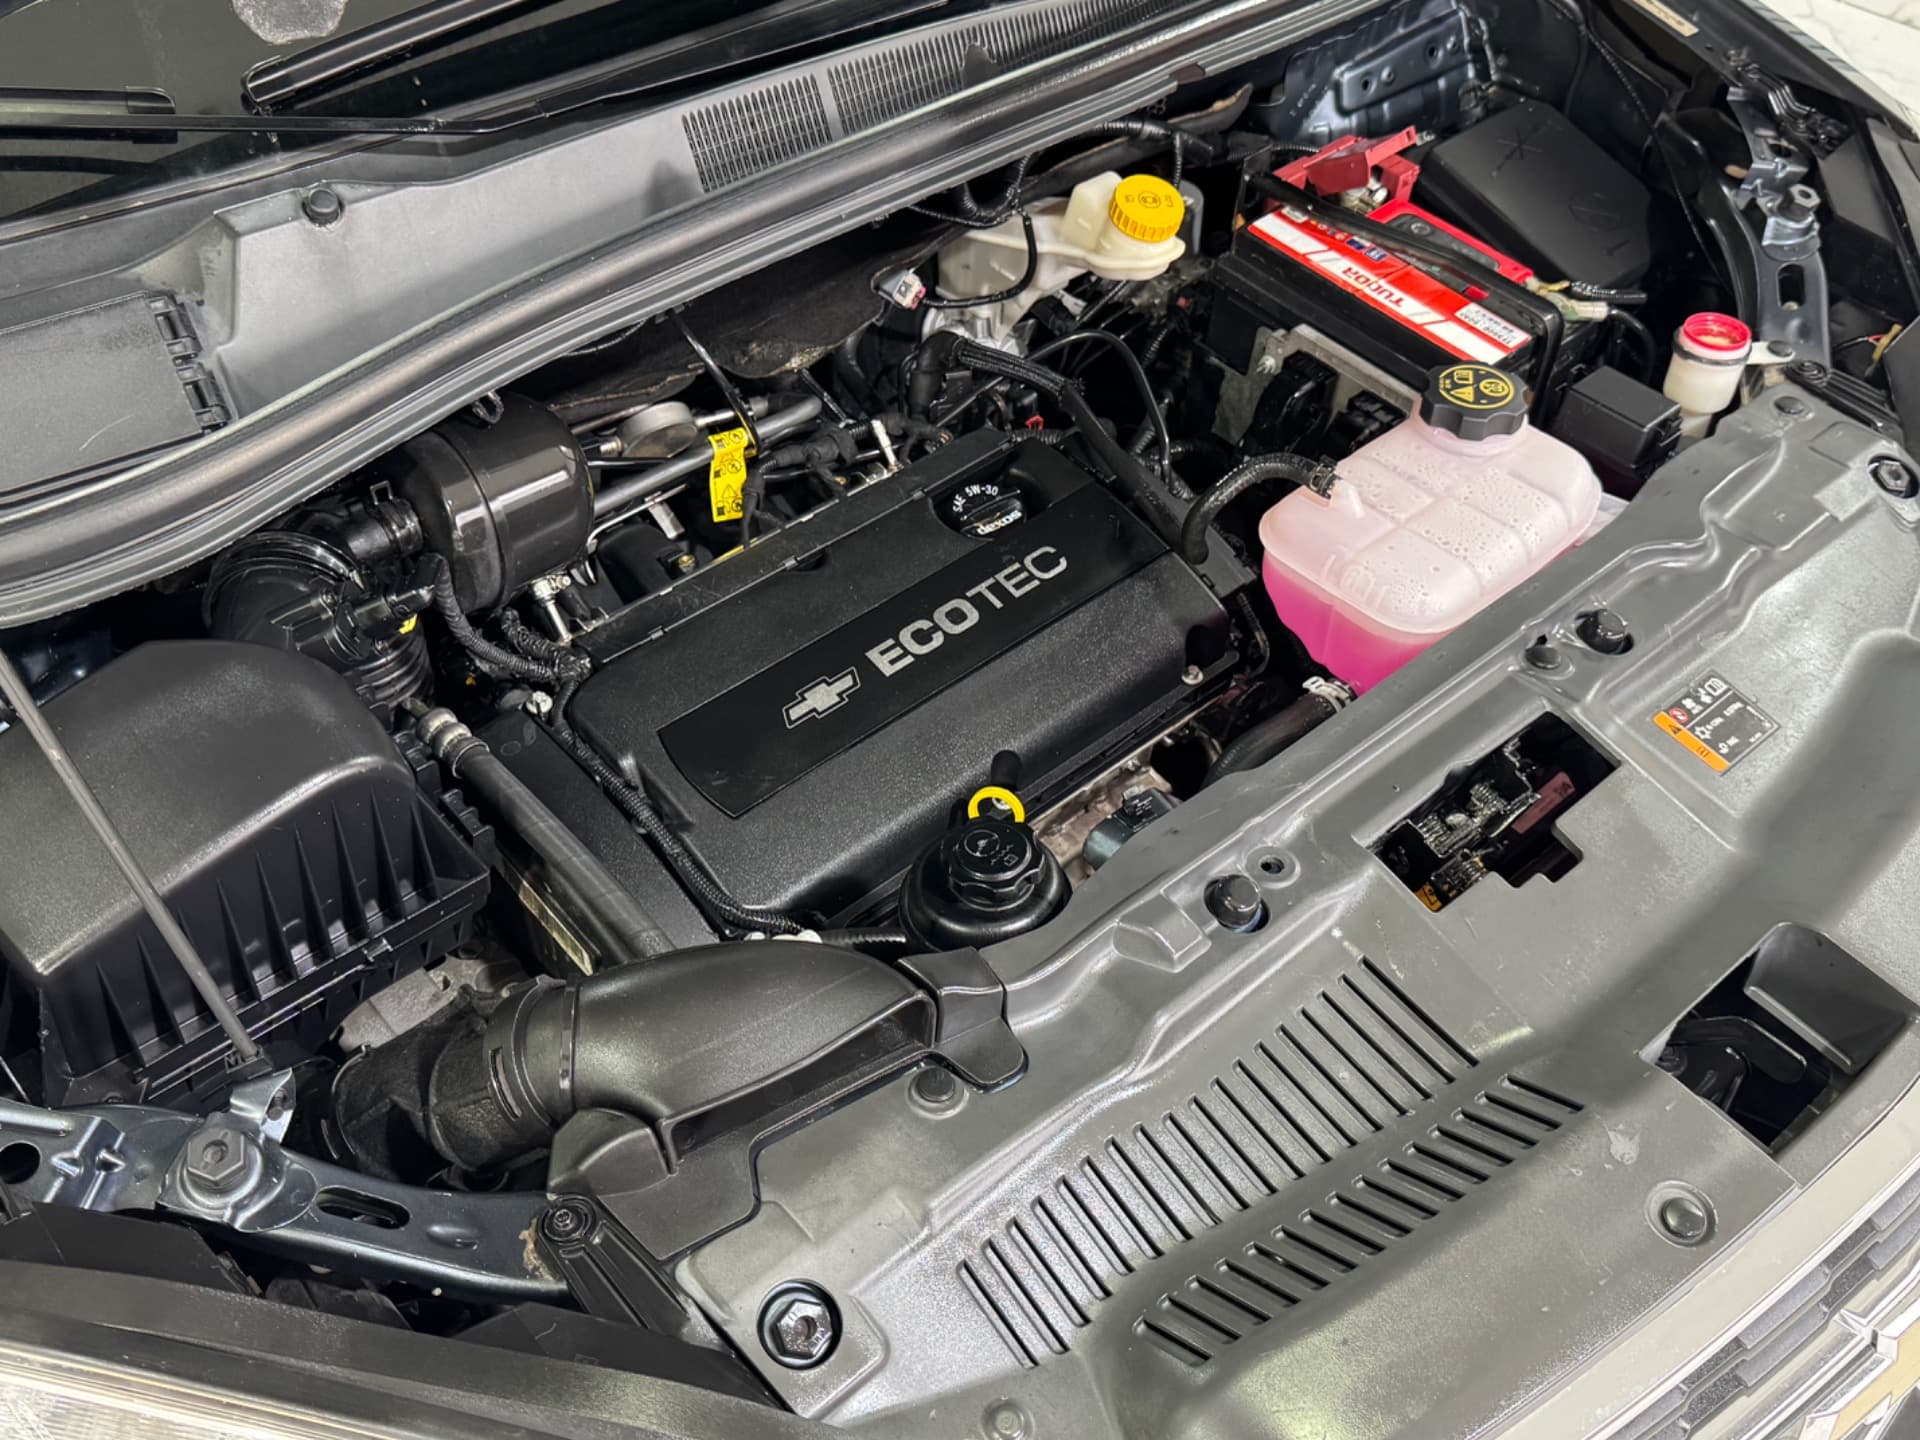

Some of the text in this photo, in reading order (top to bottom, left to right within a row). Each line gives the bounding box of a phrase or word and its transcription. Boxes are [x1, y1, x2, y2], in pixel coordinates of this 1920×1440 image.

[1341, 266, 1404, 308] TUDOR
[952, 484, 999, 512] SAE 5W-30
[976, 510, 1022, 535] dexos
[865, 546, 1068, 677] ECOTEC
